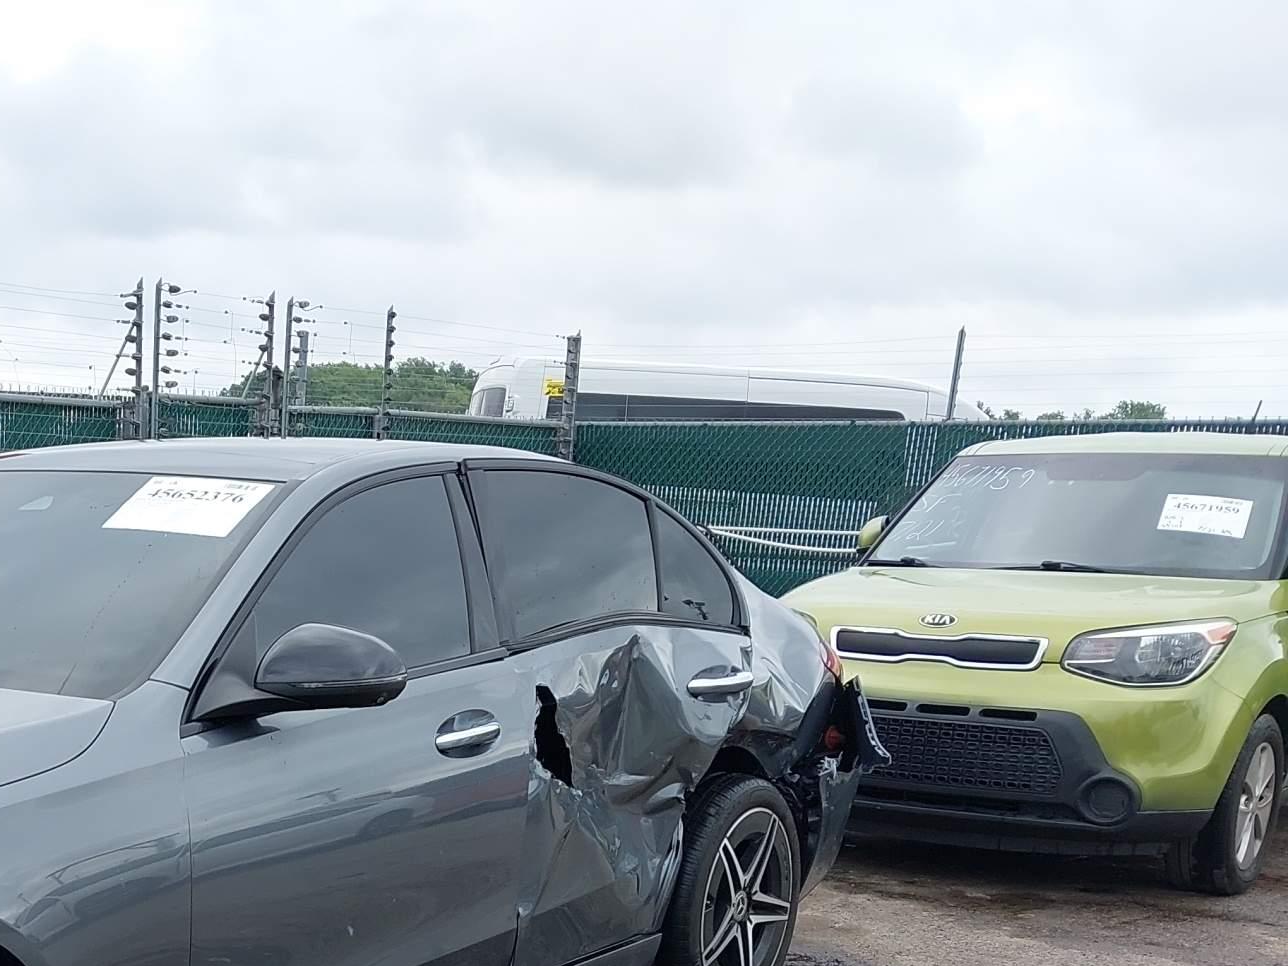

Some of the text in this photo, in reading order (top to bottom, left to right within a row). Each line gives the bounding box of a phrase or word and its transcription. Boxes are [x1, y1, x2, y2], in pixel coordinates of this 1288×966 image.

[147, 487, 244, 504] 45652376
[1173, 501, 1241, 514] 45671959
[923, 613, 952, 626] KIA
